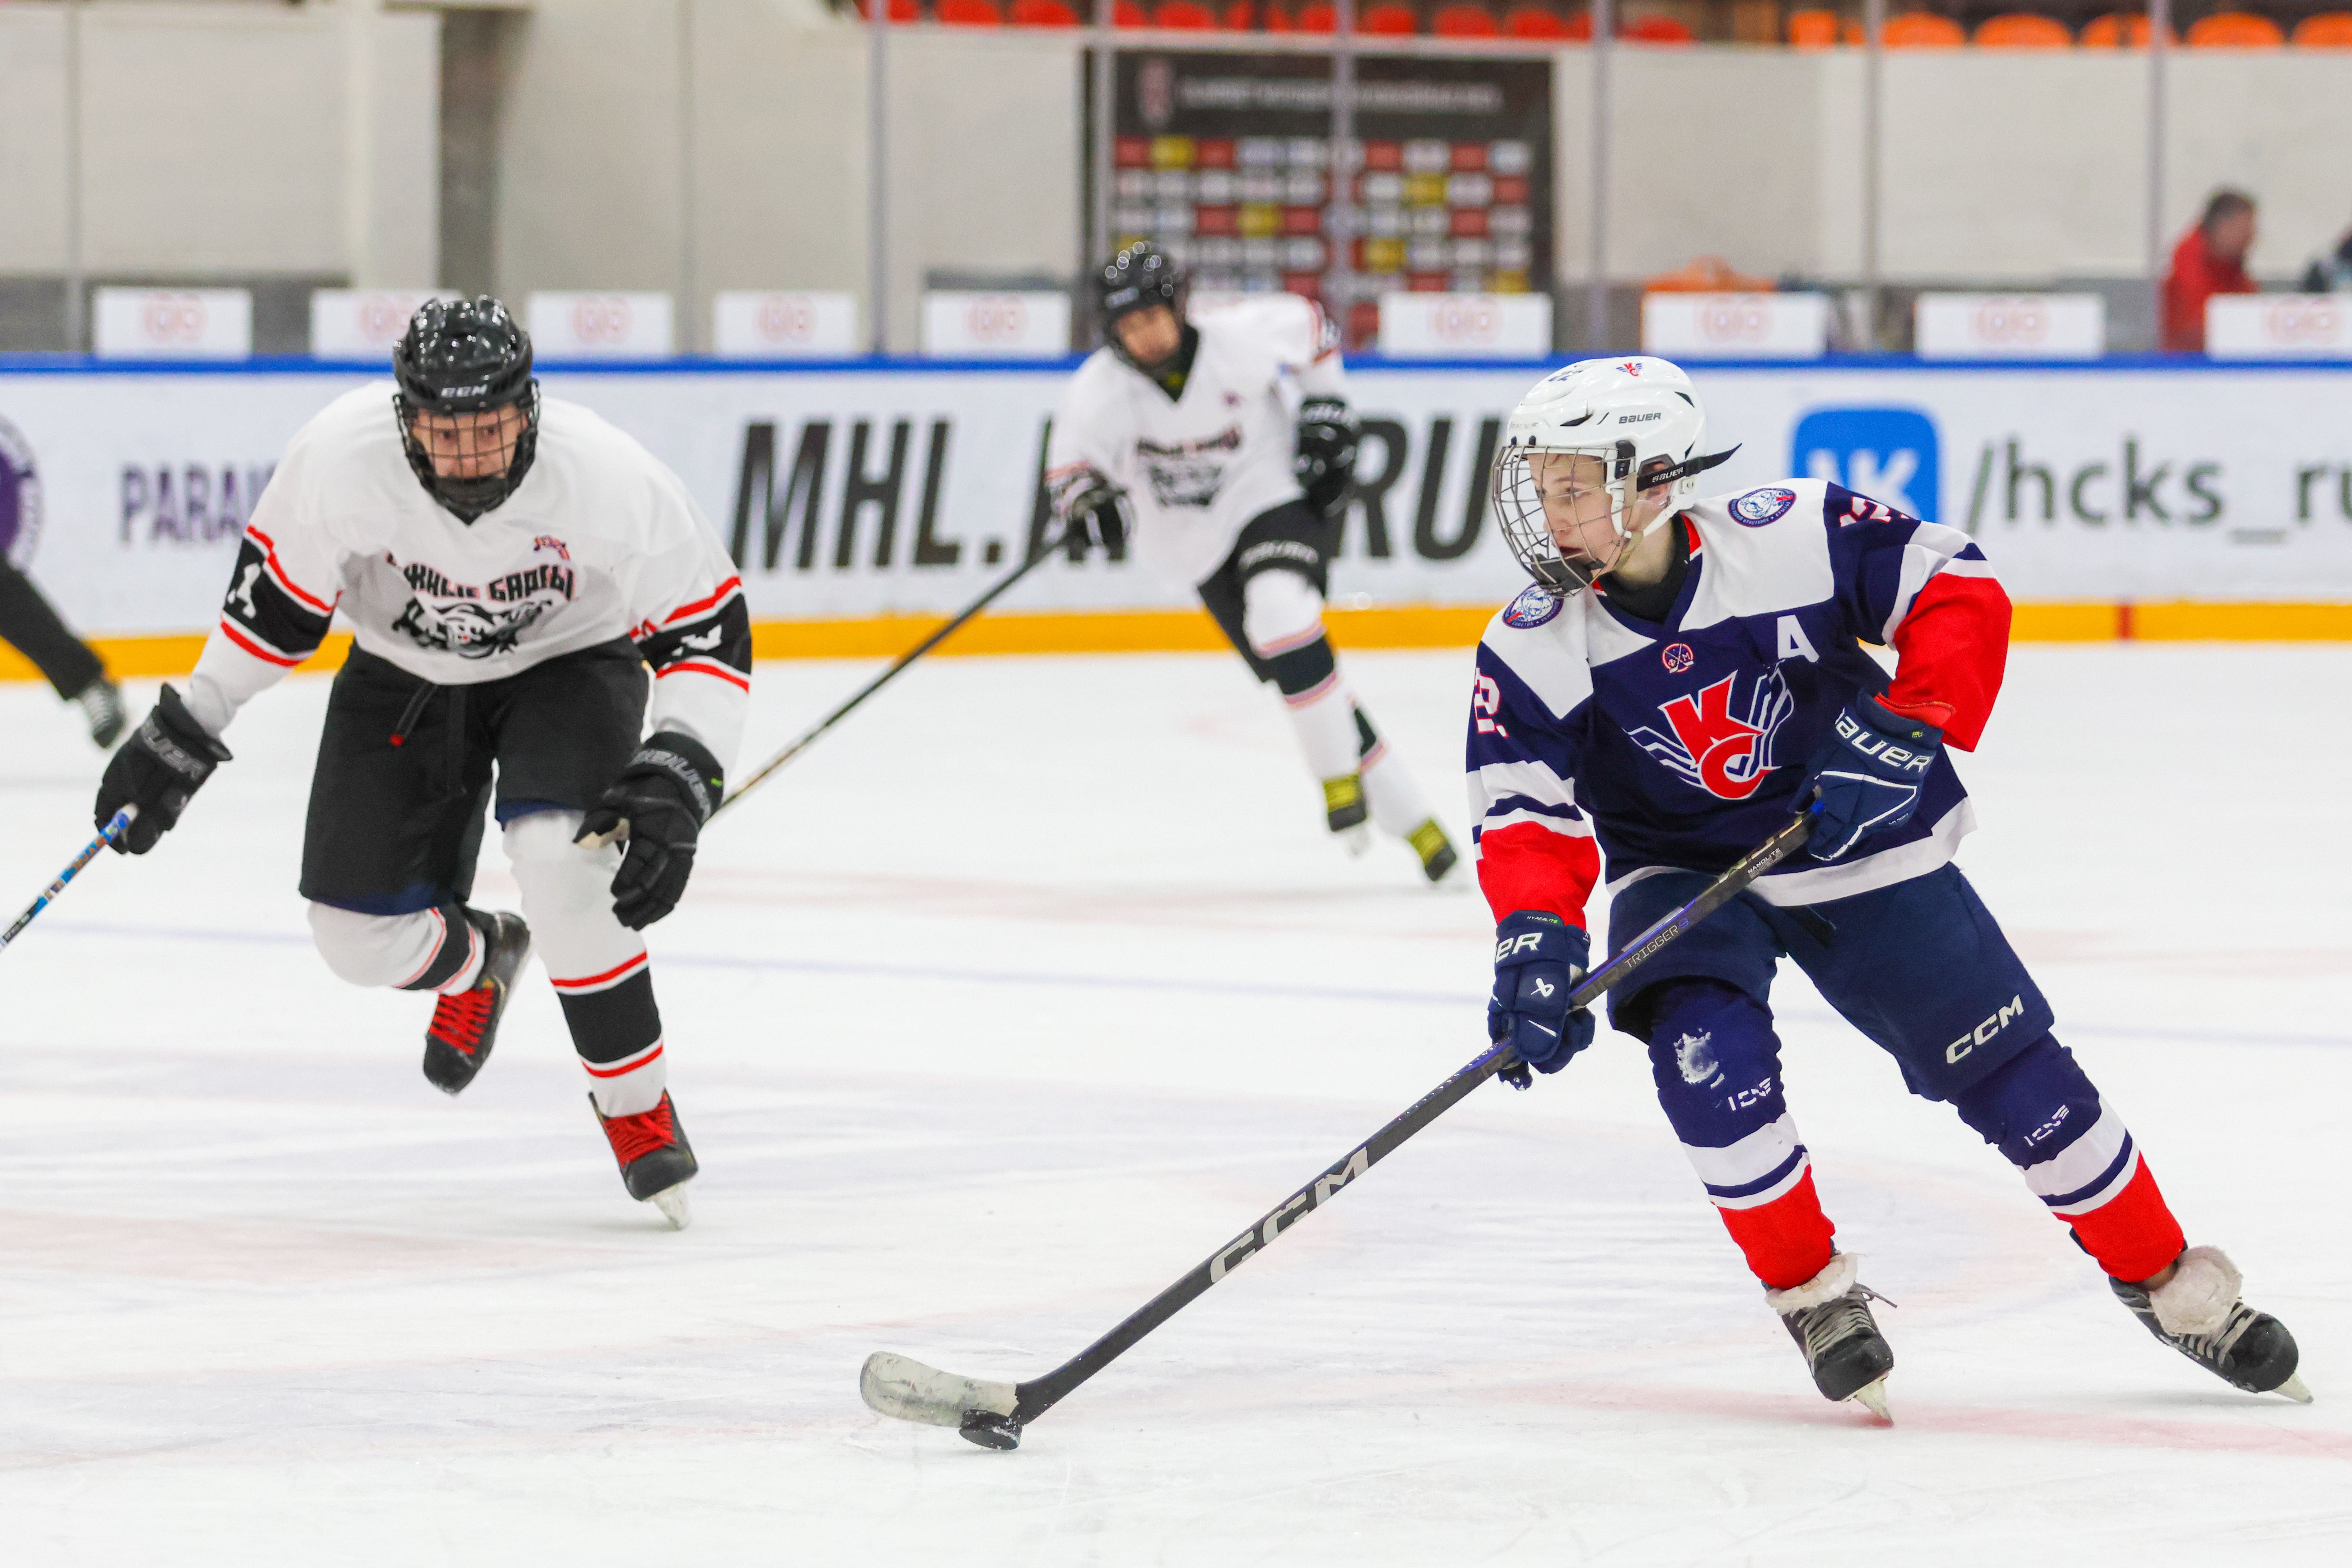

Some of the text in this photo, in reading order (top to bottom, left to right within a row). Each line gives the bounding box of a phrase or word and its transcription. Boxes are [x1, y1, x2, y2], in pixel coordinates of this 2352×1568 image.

[1777, 614, 1820, 663] A
[1835, 707, 1933, 774] AUER
[1748, 847, 1780, 874] NANOLITE
[1624, 925, 1679, 968] TRIGGER
[1946, 993, 2024, 1064] CCM
[1210, 1146, 1369, 1283] CCM
